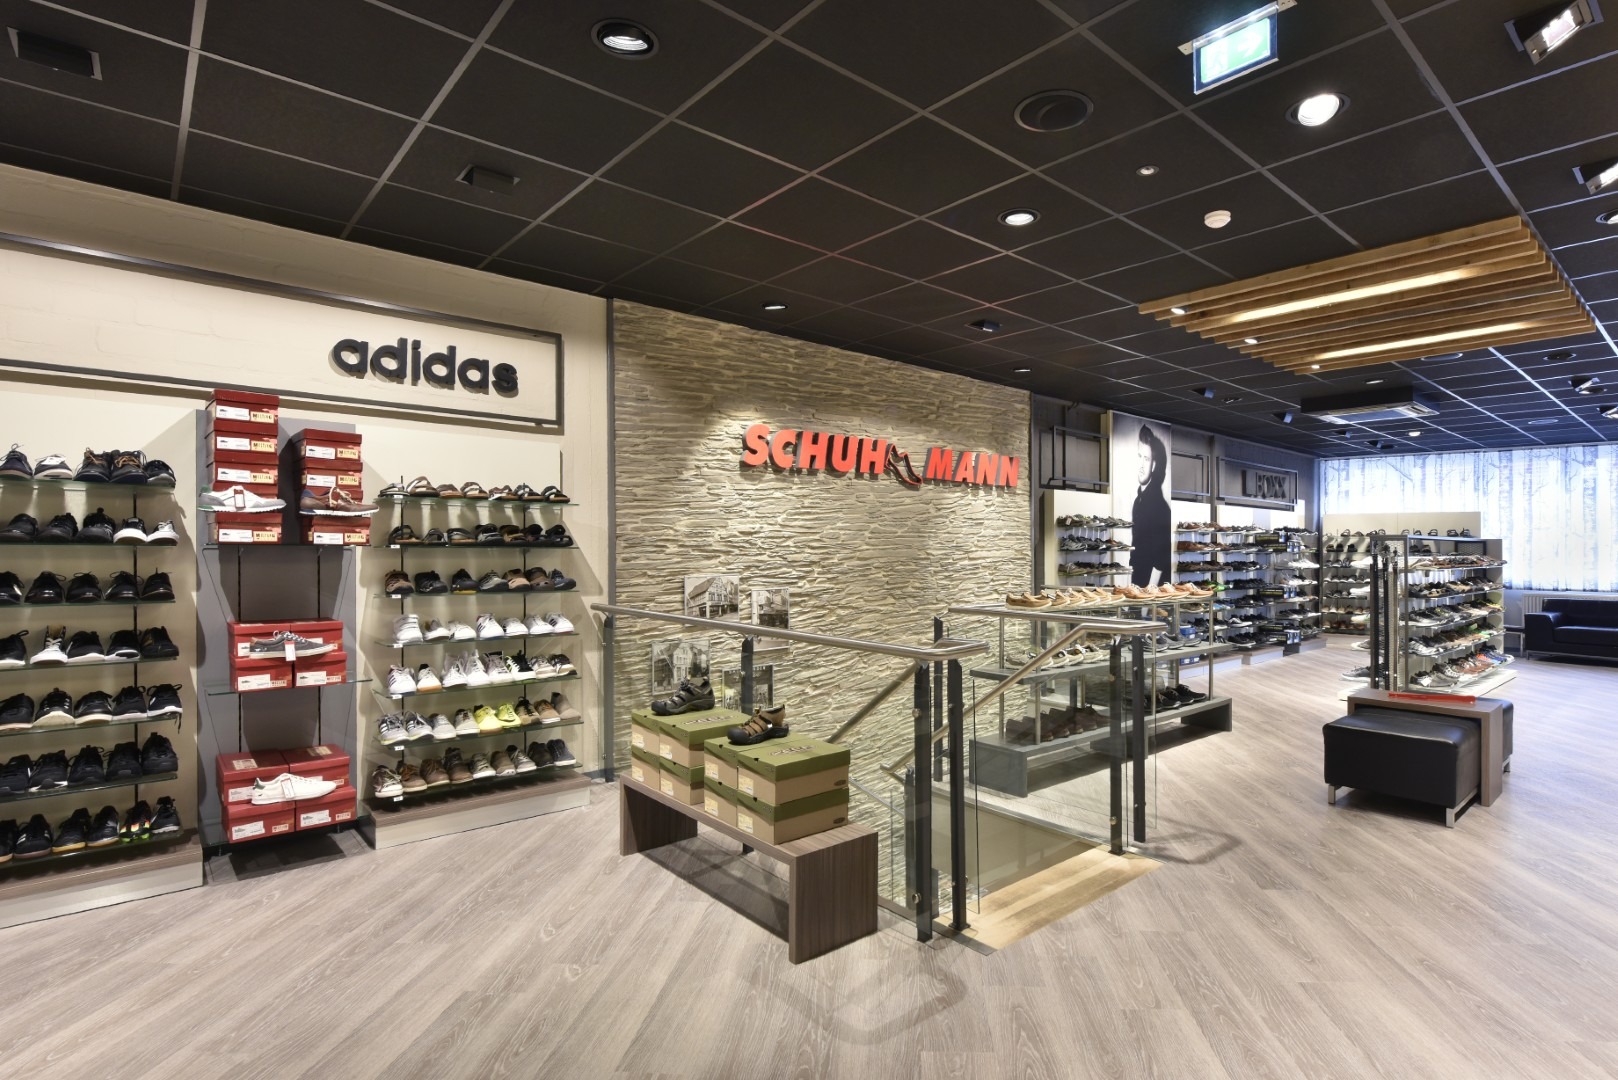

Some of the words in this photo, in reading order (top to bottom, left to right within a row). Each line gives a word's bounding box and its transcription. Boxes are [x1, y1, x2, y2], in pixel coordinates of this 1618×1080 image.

[333, 337, 518, 394] adidas
[741, 423, 887, 474] SCHUH
[924, 447, 1020, 487] MANN
